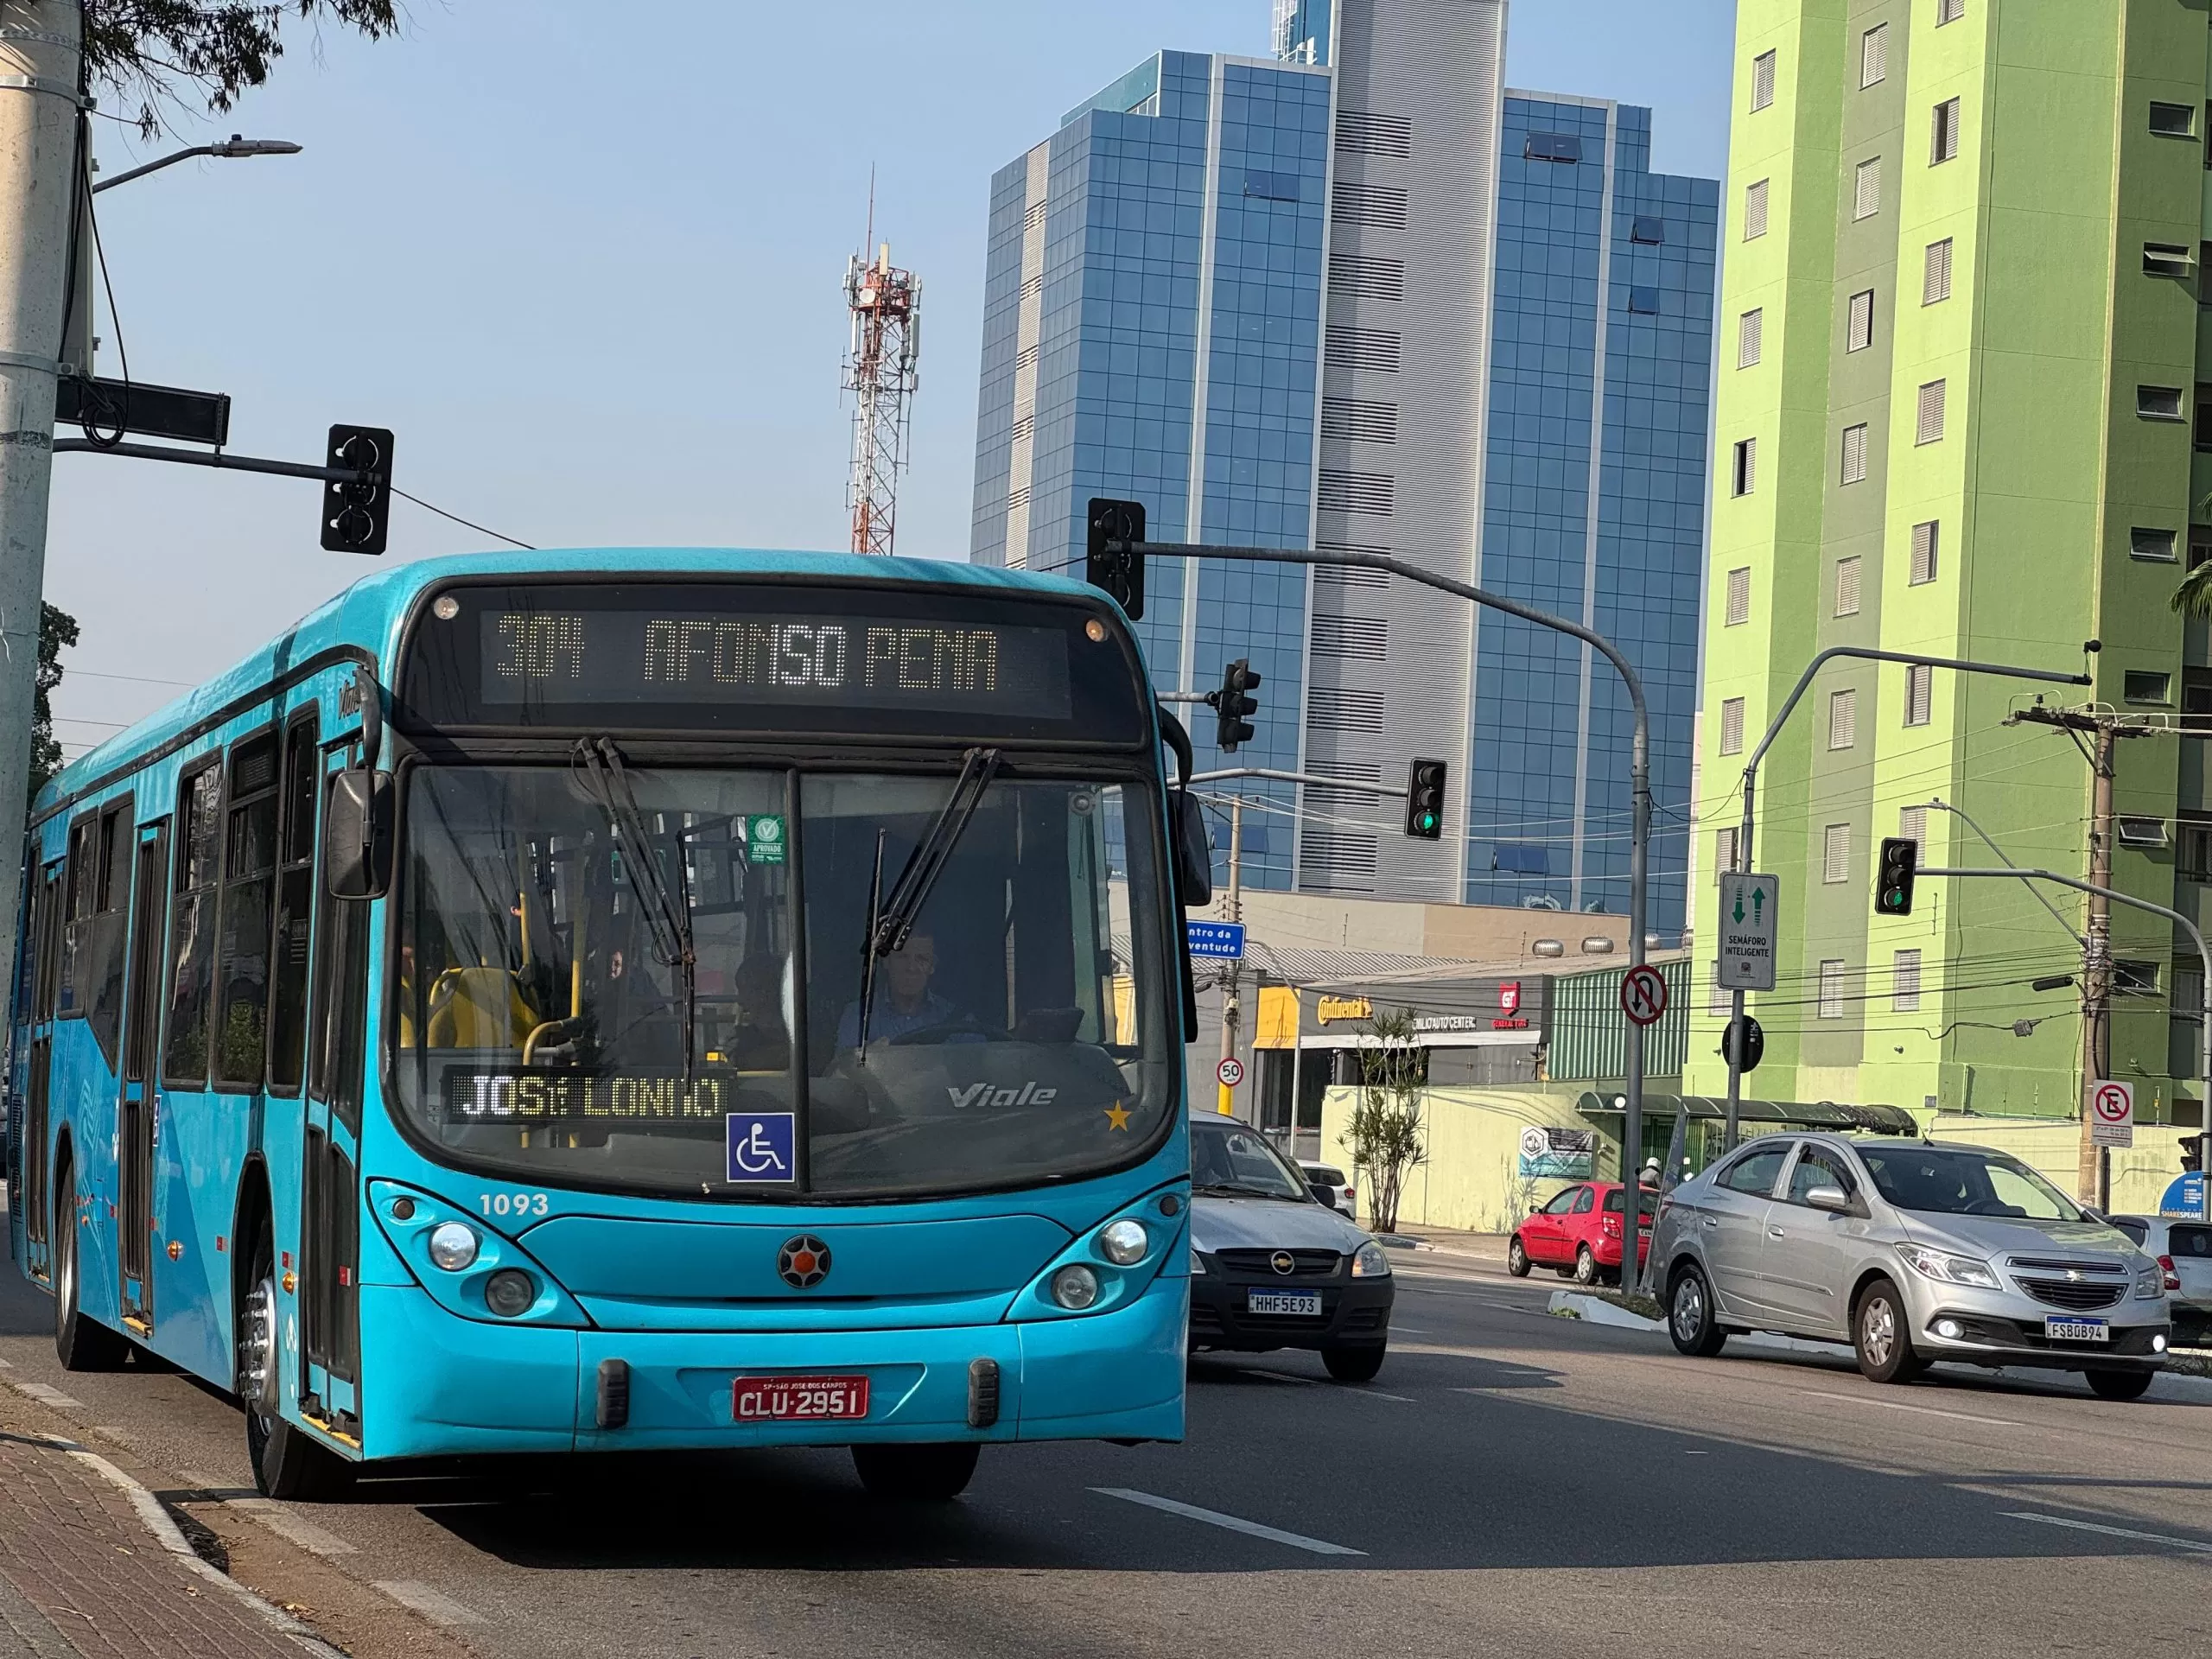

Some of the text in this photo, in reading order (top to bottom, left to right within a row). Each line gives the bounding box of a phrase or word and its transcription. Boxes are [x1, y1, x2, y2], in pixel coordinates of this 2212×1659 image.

[497, 615, 997, 690] 304 AFONSO PENA
[1189, 927, 1231, 939] ntro da
[1728, 934, 1767, 946] SEMÁFORO
[1188, 942, 1236, 953] ventude
[1725, 946, 1770, 957] INTELIGENTE
[1318, 995, 1363, 1025] Continental
[1432, 1017, 1449, 1030] AUTO
[1450, 1016, 1474, 1029] CENTER
[1222, 1065, 1240, 1077] 50
[947, 1082, 1058, 1108] Viale
[480, 1194, 549, 1216] 1093
[1255, 1296, 1314, 1312] HHF5E93
